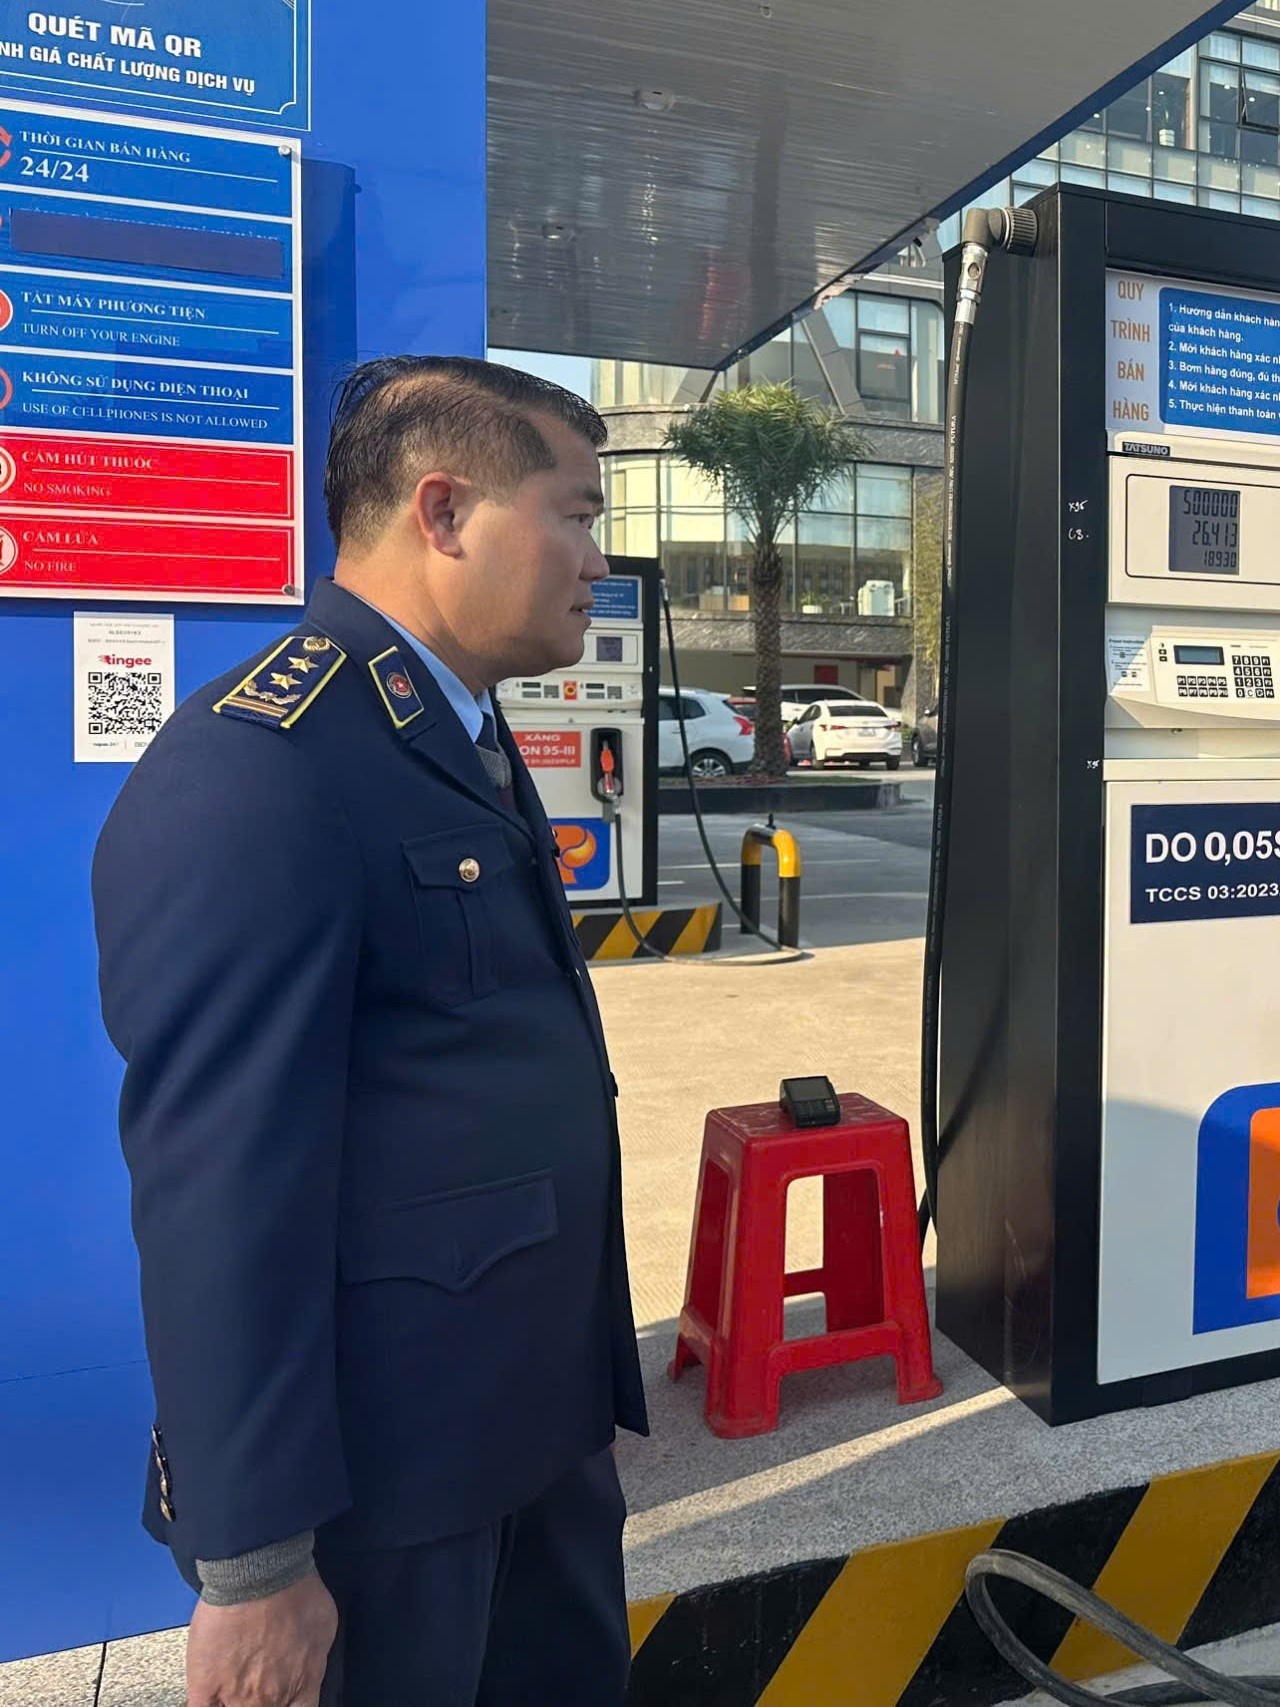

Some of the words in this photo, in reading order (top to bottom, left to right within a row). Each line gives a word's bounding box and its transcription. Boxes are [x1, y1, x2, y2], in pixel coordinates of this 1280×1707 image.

[28, 12, 101, 42] QUÉT
[110, 25, 156, 51] MÃ
[165, 34, 201, 58] QR
[29, 46, 62, 65] GIÁ
[67, 52, 116, 72] CHẤT
[120, 60, 180, 83] LƯỢNG
[186, 69, 227, 90] DỊCH
[232, 76, 255, 96] VỤ
[19, 130, 61, 146] THỜI
[65, 136, 105, 151] GIAN
[110, 141, 142, 157] BÁN
[145, 146, 191, 163] HÀNG
[20, 155, 90, 183] 24/24
[1117, 280, 1145, 301] QUY
[58, 292, 95, 309] MÁY
[98, 298, 166, 315] PHƯƠNG
[169, 305, 206, 321] TIỆN
[21, 322, 59, 336] TURN
[62, 325, 88, 338] OFF
[90, 328, 128, 343] YOUR
[131, 332, 181, 347] ENGINE
[1111, 318, 1151, 343] TRÌNH
[1168, 322, 1186, 333] của
[1187, 324, 1216, 337] khách
[1218, 329, 1244, 342] hàng.
[1168, 341, 1177, 351] 2.
[1179, 342, 1198, 353] Mời
[1200, 345, 1228, 358] khách
[1230, 349, 1252, 363] hàng
[1254, 353, 1271, 363] xác
[1117, 359, 1145, 381] BÁN
[1168, 360, 1177, 370] 3.
[1179, 361, 1202, 373] Bơm
[1204, 364, 1228, 379] hàng
[1230, 367, 1256, 381] đúng,
[1257, 371, 1269, 381] đủ
[22, 370, 82, 386] KHÔNG
[111, 378, 155, 392] DỤNG
[159, 381, 197, 396] ĐIỆN
[200, 385, 249, 401] THOẠI
[1168, 379, 1177, 389] 4.
[1179, 380, 1198, 392] Mời
[1200, 383, 1228, 395] khách
[1230, 386, 1252, 400] hàng
[1254, 390, 1271, 400] xác
[22, 402, 49, 414] USE
[51, 404, 70, 415] OF
[72, 406, 158, 421] CELLPHONES
[161, 412, 173, 422] IS
[176, 413, 203, 424] NOT
[205, 416, 268, 429] ALLOWED
[1112, 397, 1149, 421] HÀNG
[1168, 399, 1177, 409] 5.
[1179, 399, 1205, 413] Thực
[1206, 402, 1226, 415] hiện
[1228, 405, 1254, 417] thanh
[1256, 409, 1276, 419] toán
[1124, 443, 1168, 455] TATSUNO
[23, 482, 44, 492] NO
[47, 484, 111, 496] SMOKING
[1183, 489, 1239, 518] 500000
[24, 560, 44, 571] NO
[47, 561, 75, 572] FIRE
[1204, 550, 1237, 568] 18930
[103, 654, 152, 668] tingee
[520, 745, 540, 756] ON
[543, 745, 576, 756] 95-III
[1146, 832, 1197, 863] DO
[1145, 886, 1201, 903] TCCS
